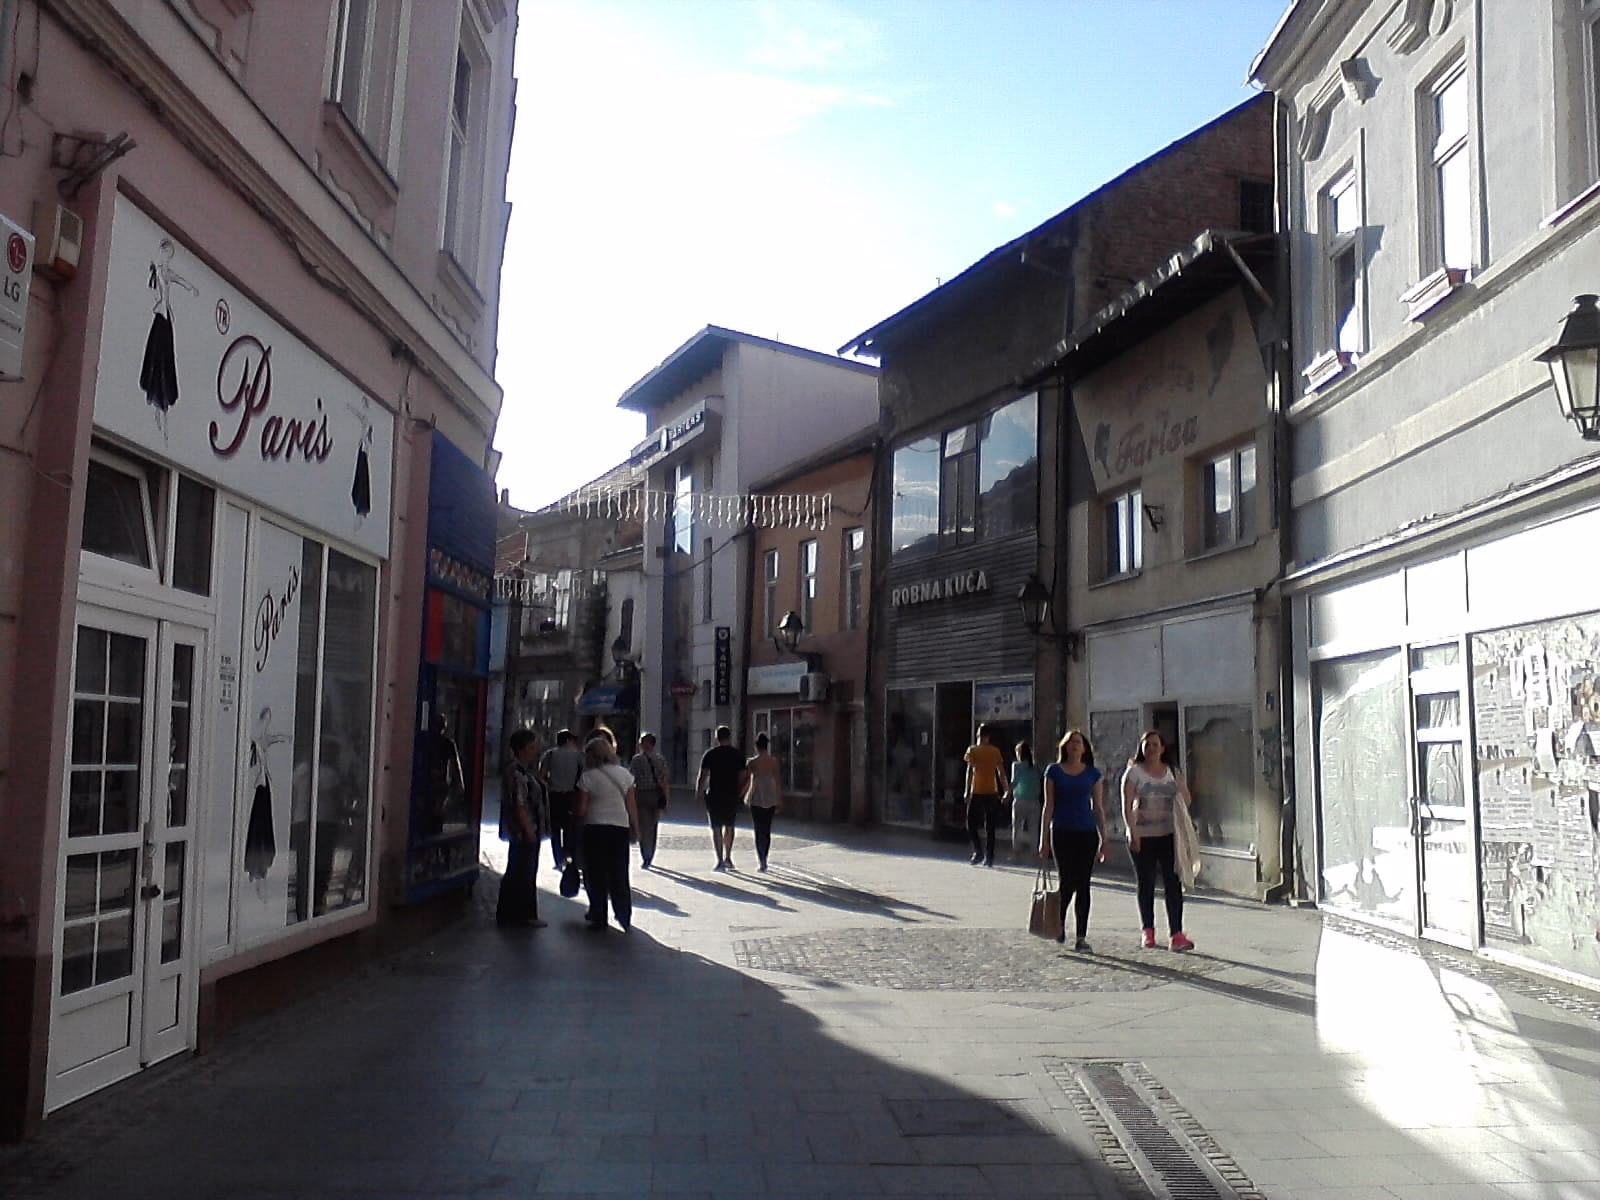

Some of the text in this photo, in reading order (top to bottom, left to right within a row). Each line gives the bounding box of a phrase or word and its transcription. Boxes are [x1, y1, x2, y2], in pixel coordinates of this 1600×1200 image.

[3, 275, 21, 303] LG
[209, 334, 333, 463] Paris
[253, 564, 300, 673] Paris
[891, 579, 941, 608] ROBNA
